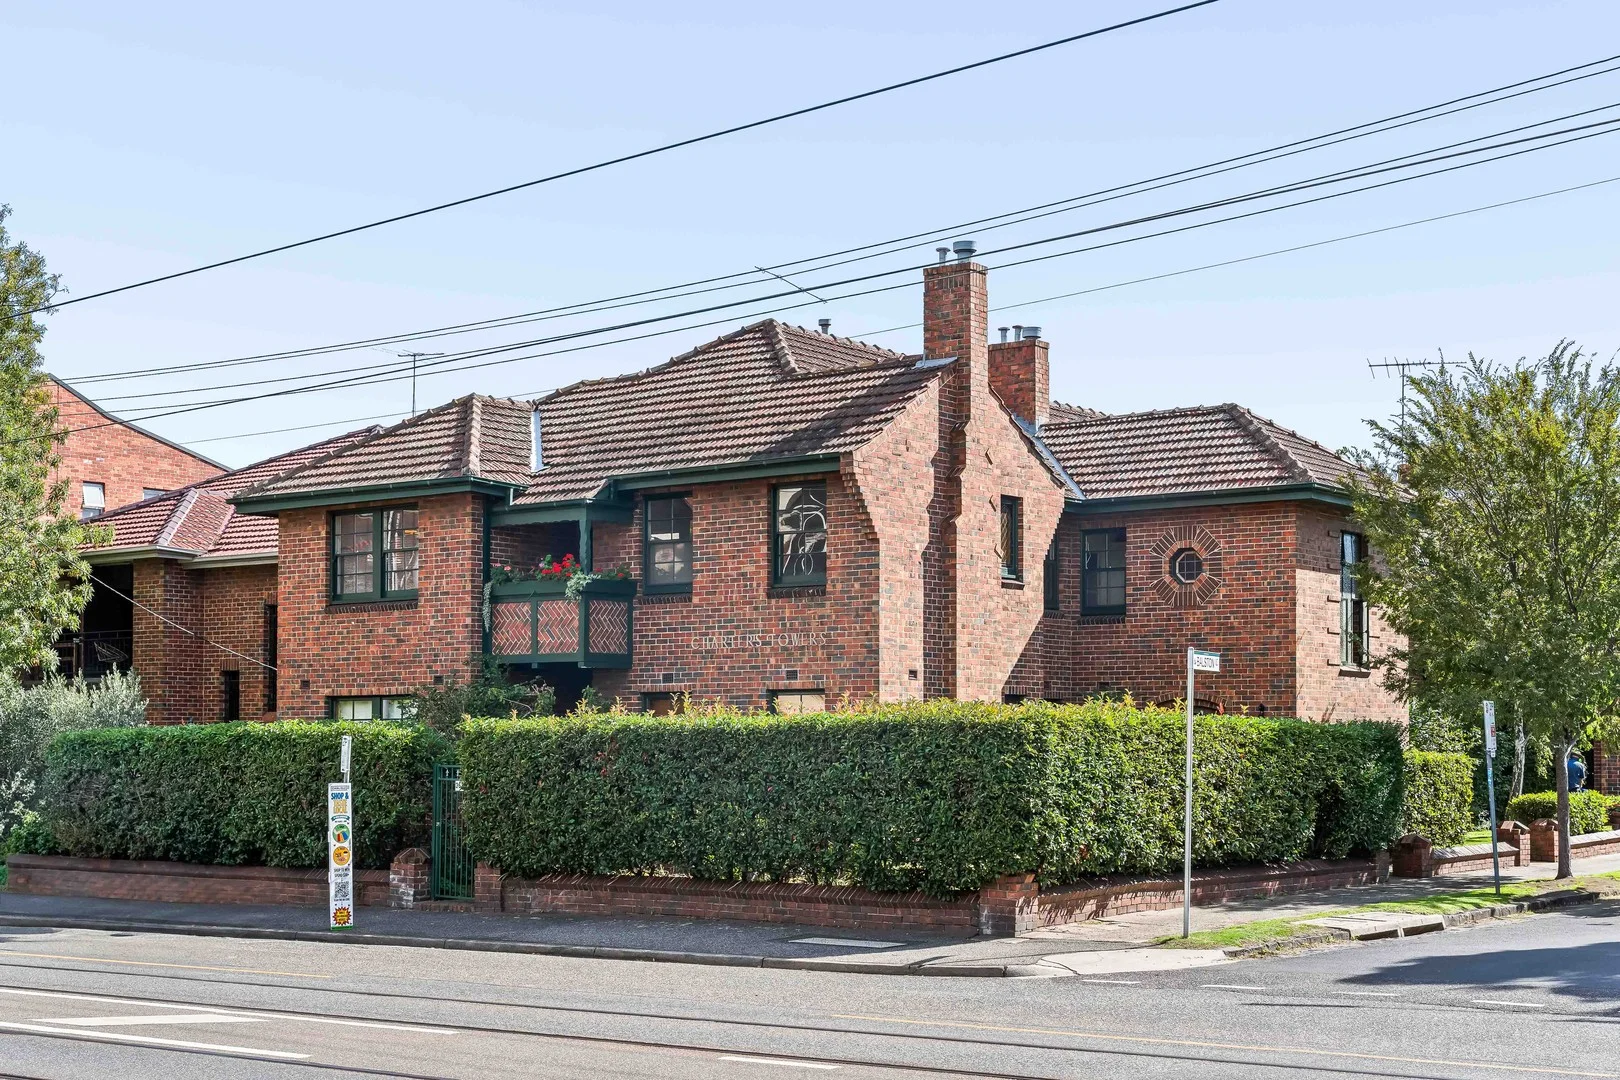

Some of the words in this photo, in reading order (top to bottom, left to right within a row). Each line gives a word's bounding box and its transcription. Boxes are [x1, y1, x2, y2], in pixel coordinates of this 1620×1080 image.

[691, 635, 762, 650] CHARTERS
[766, 632, 827, 647] TOWERS
[331, 792, 344, 800] SHOP
[345, 792, 349, 800] &
